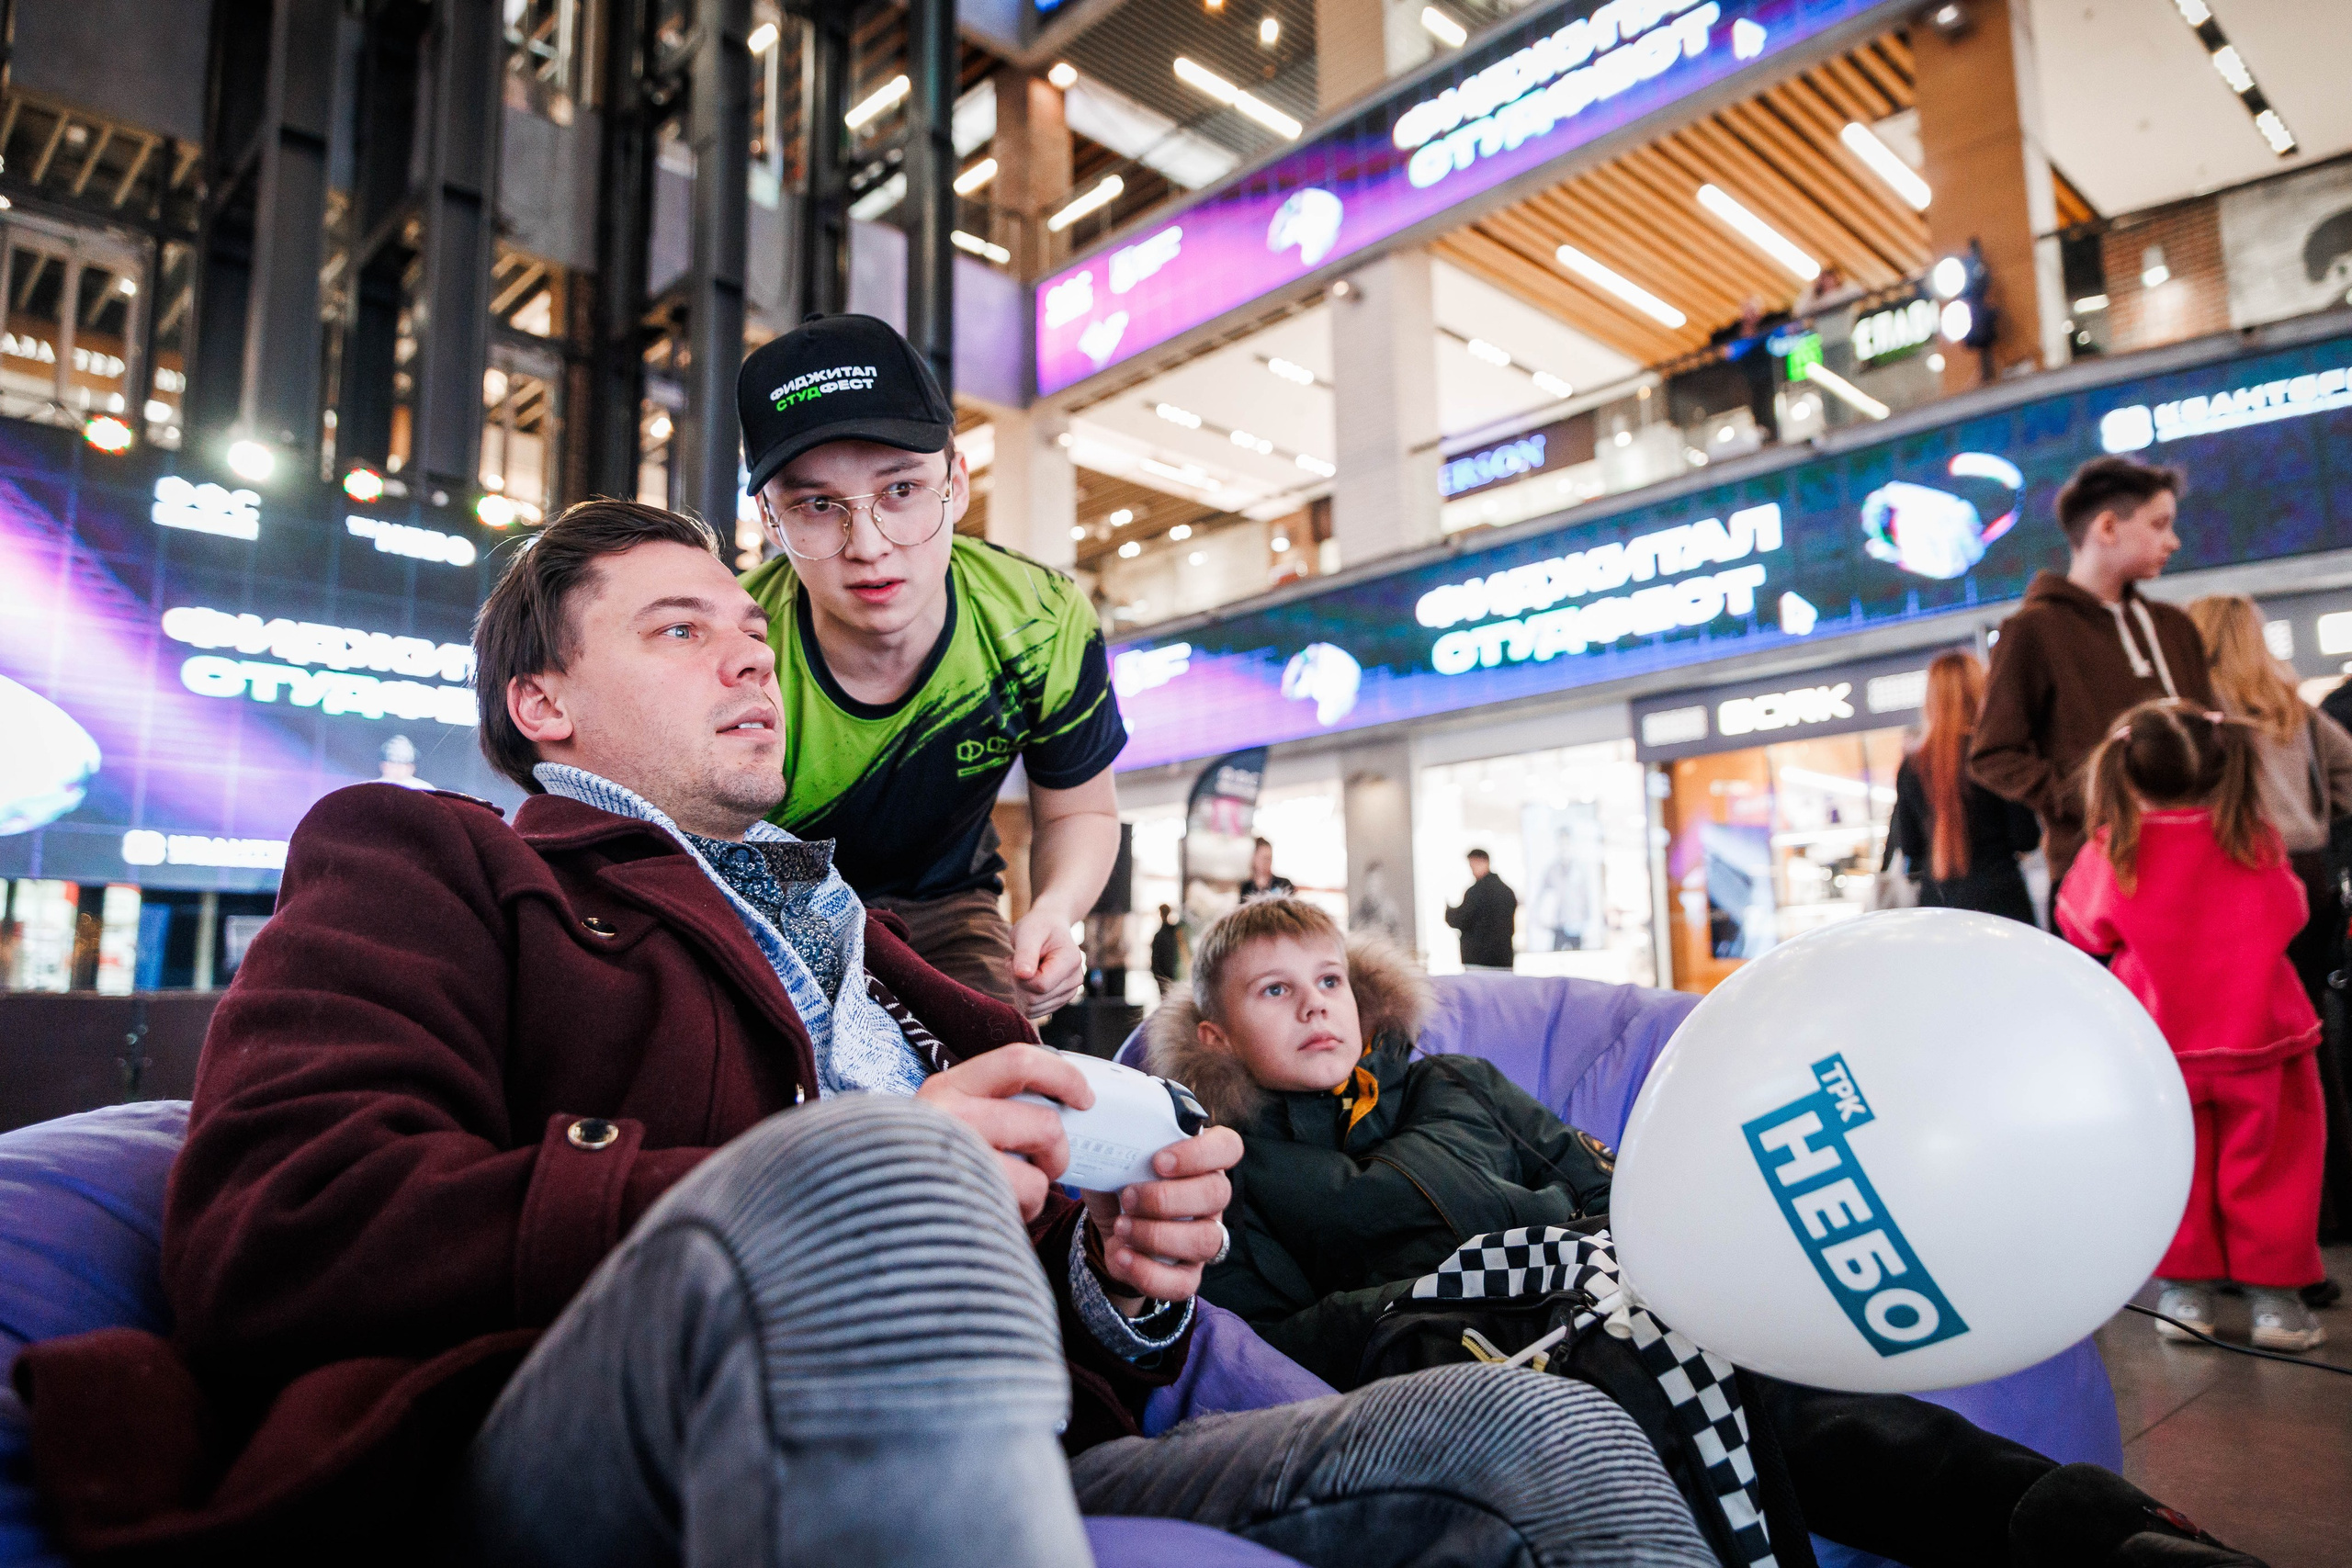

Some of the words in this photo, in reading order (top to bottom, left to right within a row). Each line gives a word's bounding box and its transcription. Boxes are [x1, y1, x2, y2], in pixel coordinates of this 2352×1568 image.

[770, 366, 877, 401] ФИДЖИТАЛ
[776, 378, 874, 412] СТУДФЕСТ
[1820, 1061, 1867, 1123] ТРК
[1758, 1110, 1940, 1343] НЕБО
